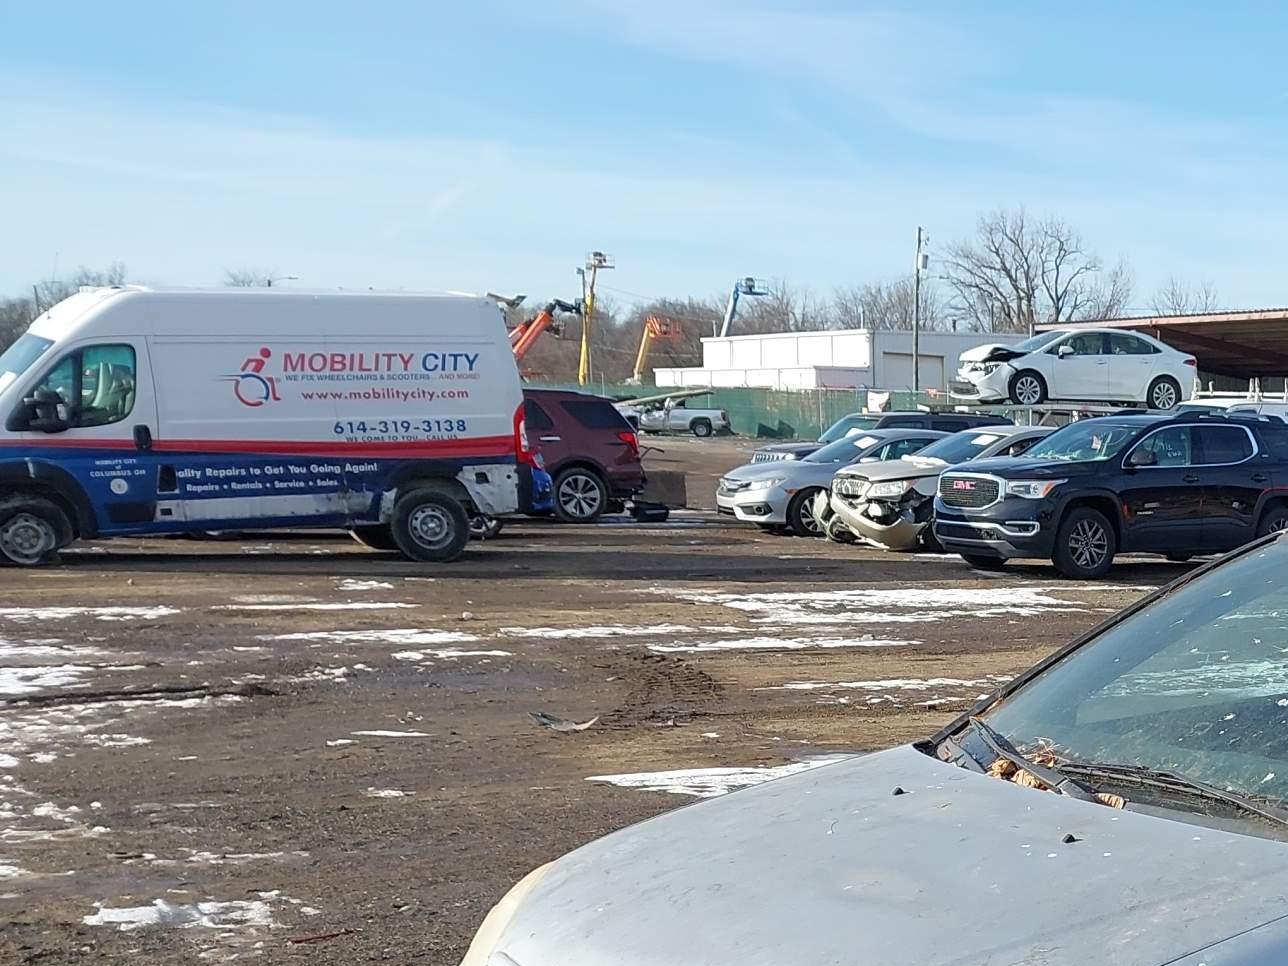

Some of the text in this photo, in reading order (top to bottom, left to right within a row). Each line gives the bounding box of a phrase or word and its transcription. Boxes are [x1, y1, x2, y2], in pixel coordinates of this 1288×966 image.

[283, 353, 479, 372] MOBILITY CITY
[302, 388, 469, 401] www.mobilitycity.com
[334, 419, 466, 434] 614-319-3138
[205, 467, 247, 478] Repairs
[249, 467, 260, 475] to
[264, 465, 283, 475] Get
[288, 464, 307, 474] You
[310, 463, 341, 474] Going
[345, 462, 378, 473] Again!
[186, 478, 339, 493] Repairs Rentals Service Sales
[953, 480, 977, 490] GMC
